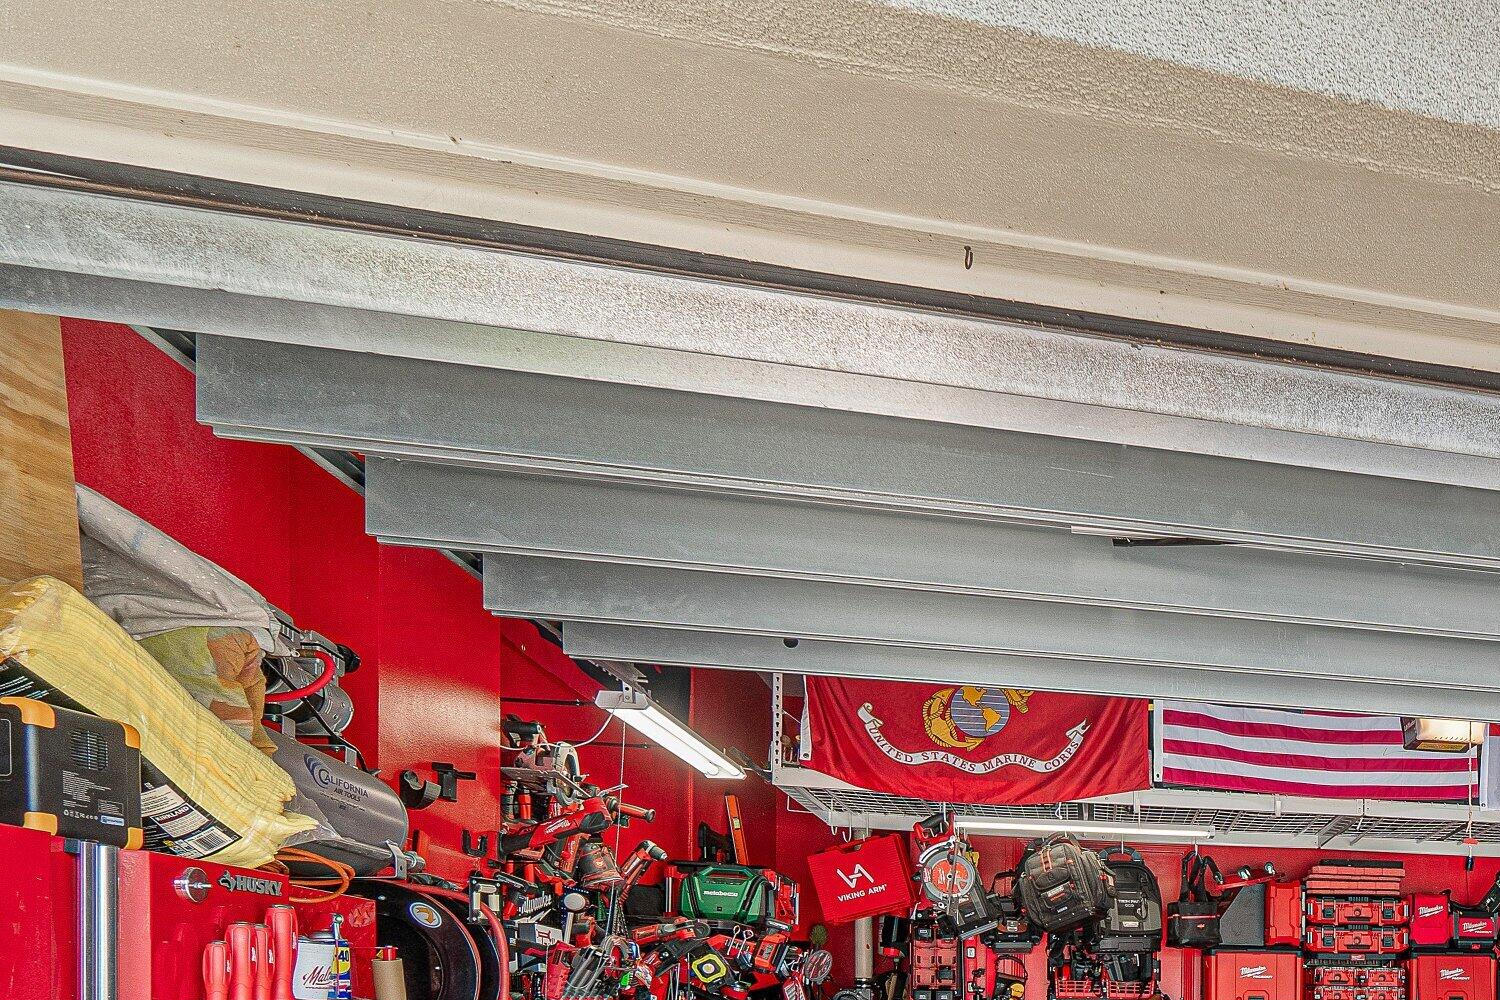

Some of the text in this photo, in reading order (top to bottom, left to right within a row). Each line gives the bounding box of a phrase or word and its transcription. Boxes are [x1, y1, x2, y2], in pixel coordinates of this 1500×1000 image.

[868, 727, 1079, 772] UNITED STATES MARINE CORPS
[319, 768, 369, 798] CALIFORNIA
[334, 787, 343, 796] AIR
[345, 790, 361, 802] TOOLS
[236, 875, 282, 897] HUSKY
[837, 889, 866, 902] VIKING
